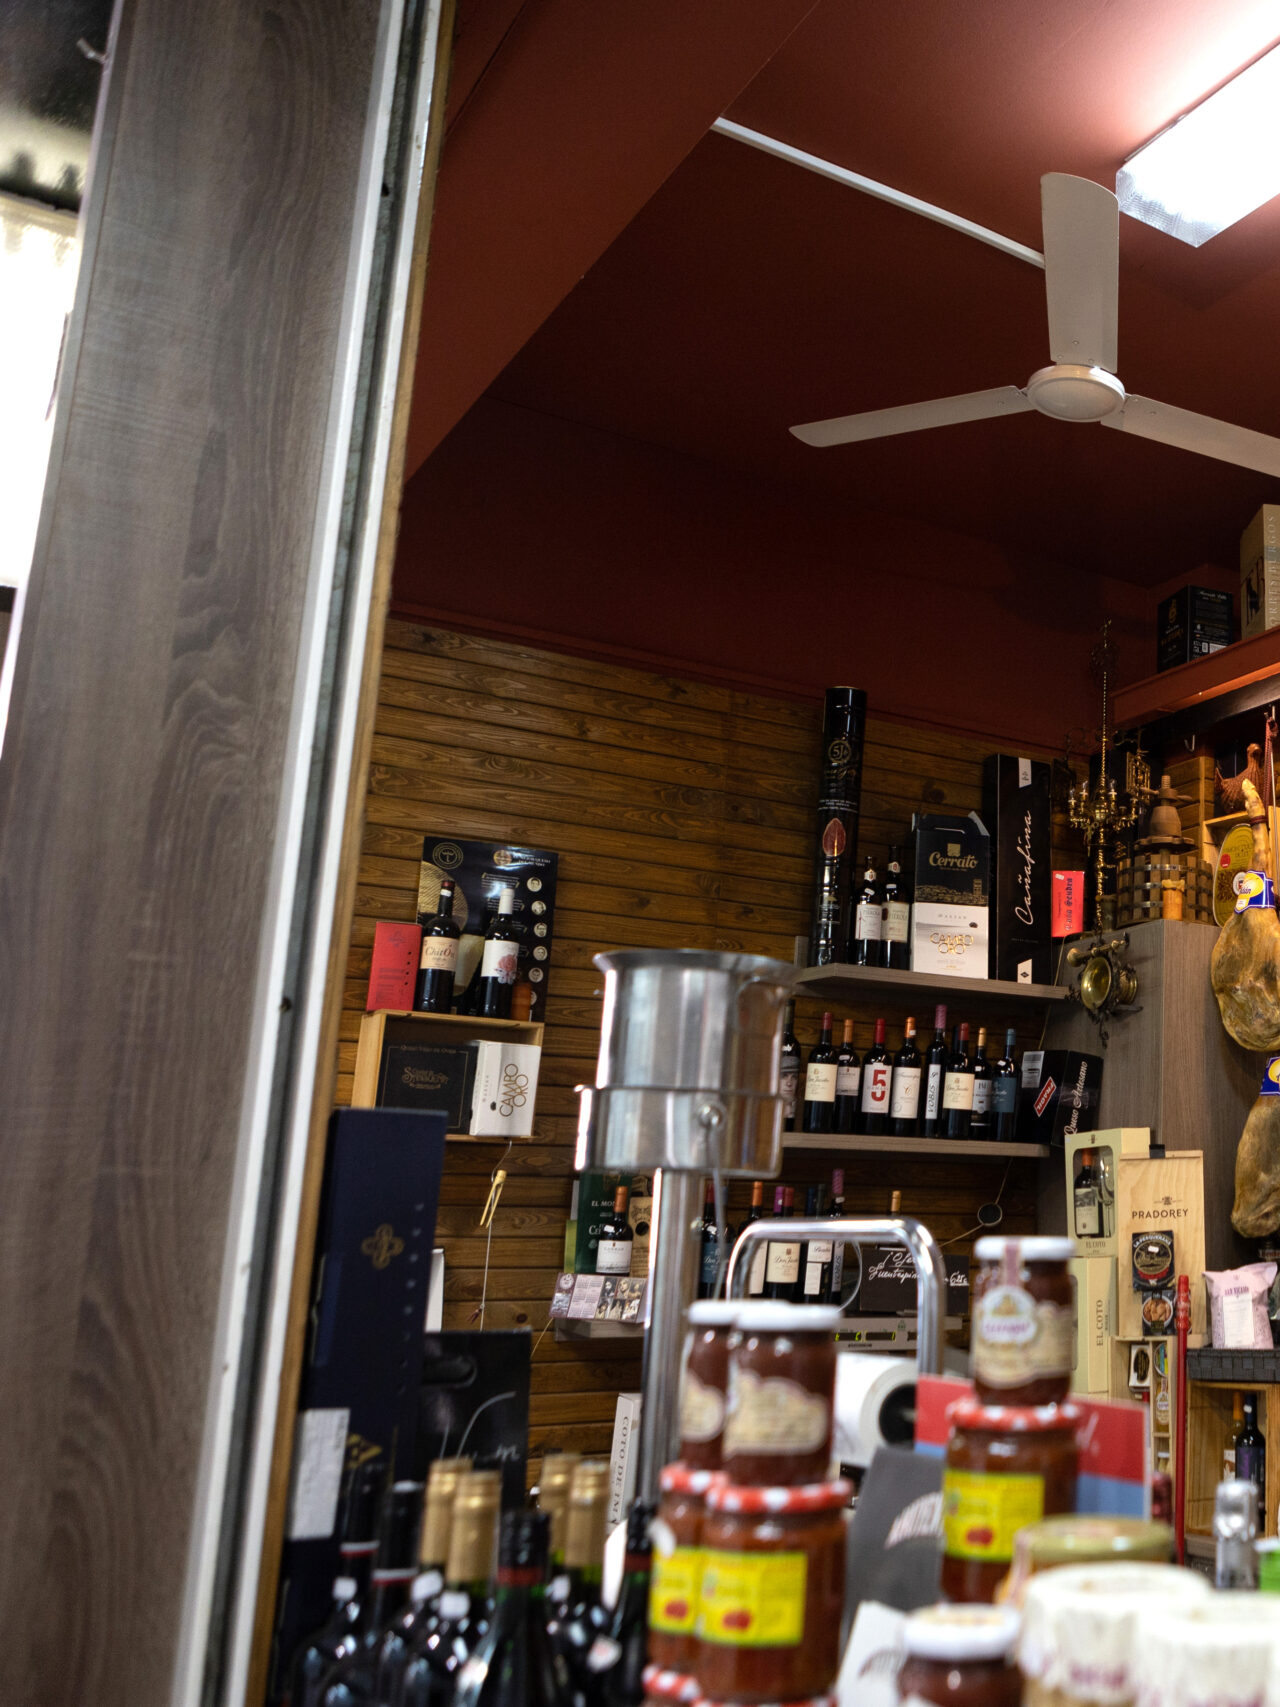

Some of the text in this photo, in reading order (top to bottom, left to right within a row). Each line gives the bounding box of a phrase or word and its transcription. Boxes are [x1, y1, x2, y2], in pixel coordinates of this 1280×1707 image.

[929, 850, 978, 869] Cerrato
[500, 1063, 518, 1117] CAMPO
[513, 1074, 529, 1107] ORO
[1064, 1061, 1088, 1135] Queso Artesano
[1131, 1208, 1189, 1220] PRADOREY
[1096, 1300, 1104, 1346] EL COTO
[619, 1416, 629, 1460] COTO
